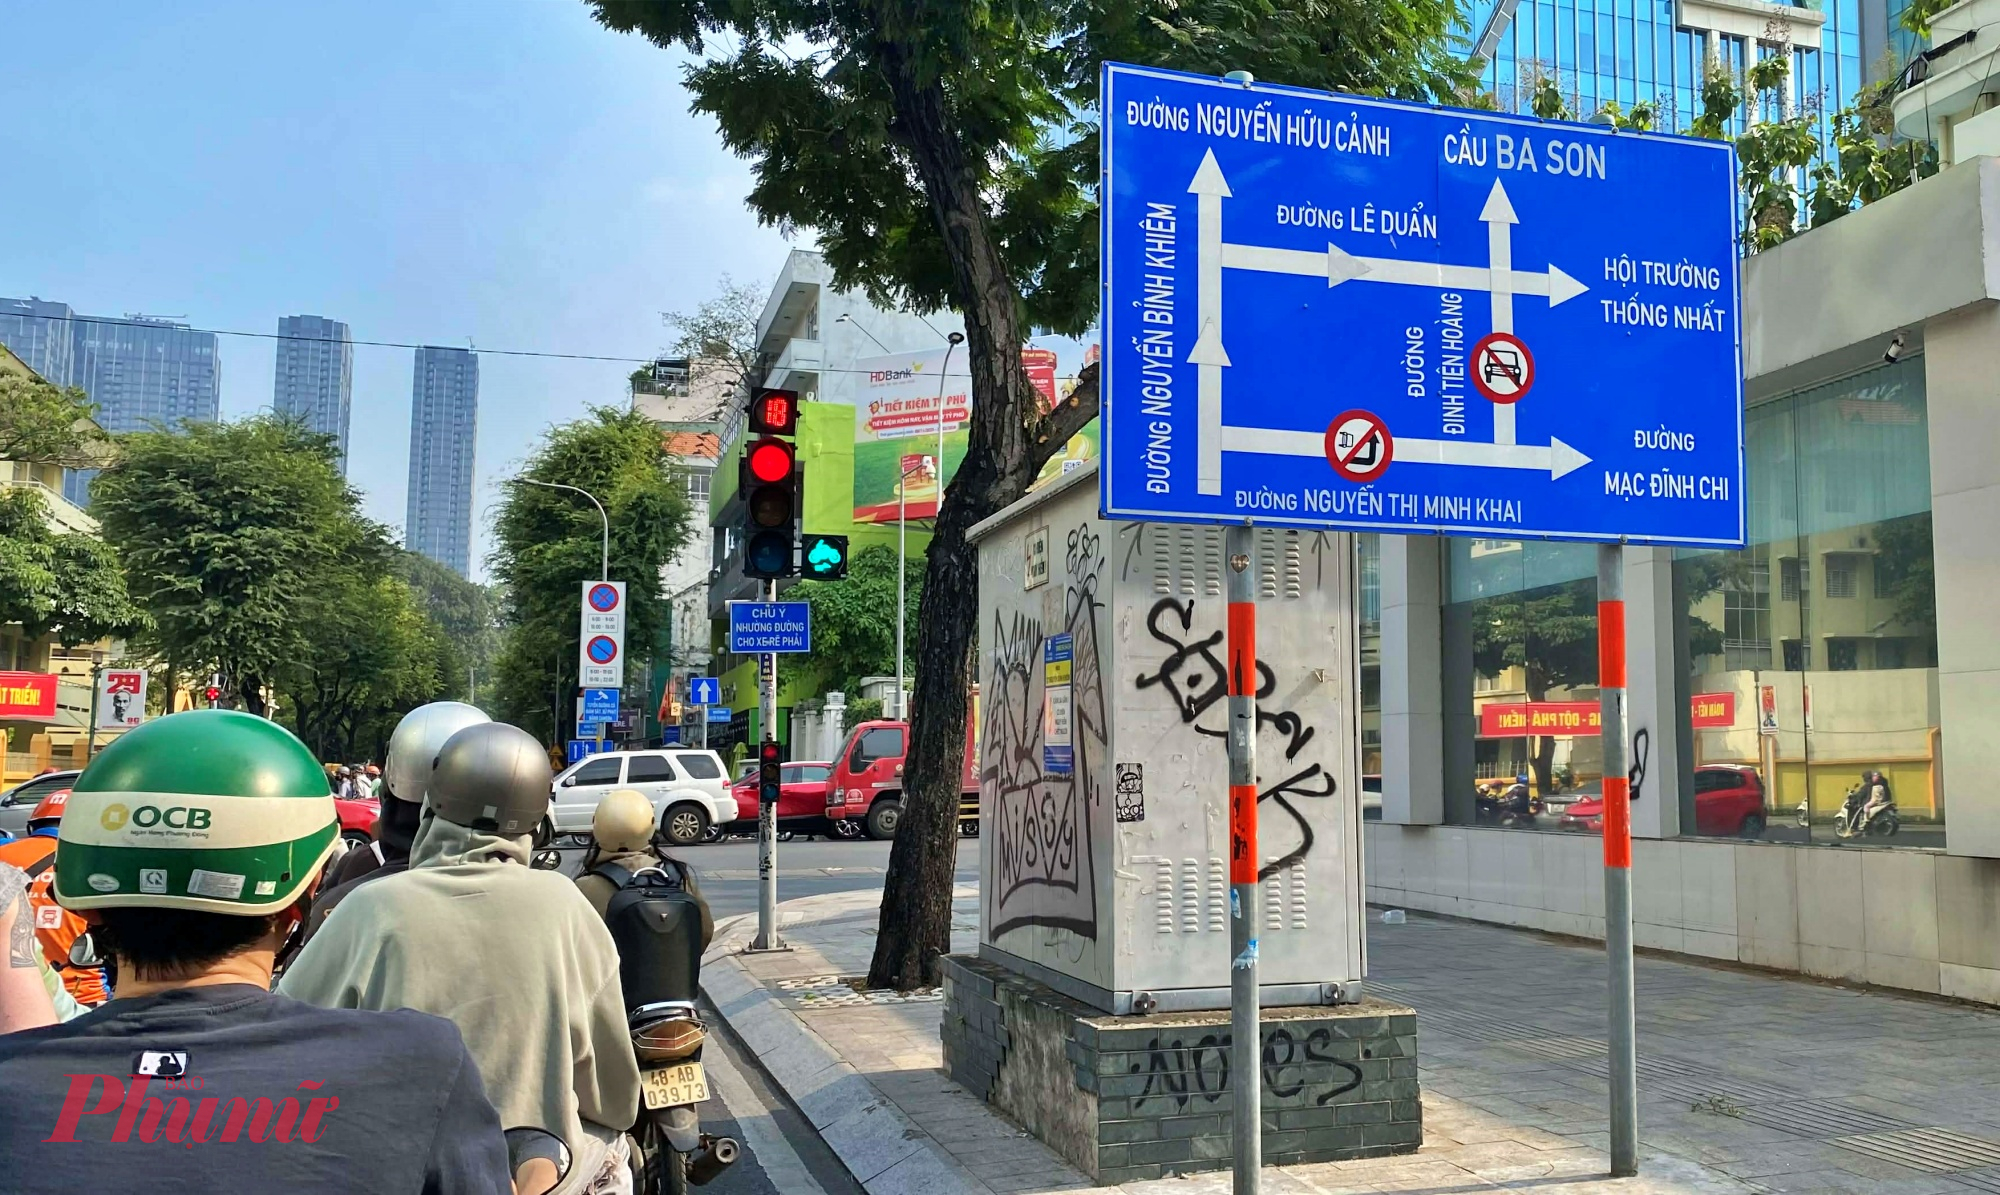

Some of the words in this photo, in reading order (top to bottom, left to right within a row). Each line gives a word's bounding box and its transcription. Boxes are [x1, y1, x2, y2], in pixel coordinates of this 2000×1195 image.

[1127, 95, 1189, 132] ĐƯỜNG
[1197, 100, 1281, 145] NGUYỄN
[1287, 109, 1331, 150] HỮU
[1335, 111, 1391, 158] CẢNH
[1444, 122, 1487, 167] CẦU
[1496, 134, 1538, 173] BA
[1545, 142, 1606, 180] SON
[1138, 202, 1176, 270] KHIÊM
[1277, 200, 1344, 230] ĐƯỜNG
[1351, 202, 1376, 234] LÊ
[1380, 202, 1437, 240] DUẨN
[1604, 252, 1637, 288] HỘI
[1642, 257, 1720, 291] TRƯỜNG
[1132, 273, 1175, 324] BỈNH
[1600, 292, 1668, 328] THỐNG
[1674, 299, 1726, 333] NHẤT
[1434, 292, 1464, 351] HOÀNG
[870, 368, 912, 383] HDBank
[1132, 329, 1174, 417] NGUYỄN
[1400, 326, 1426, 398] ĐƯỜNG
[1435, 354, 1465, 391] TIÊN
[884, 398, 902, 413] TIẾT
[905, 397, 929, 412] KIỆM
[946, 392, 966, 406] PHÚ
[1441, 394, 1466, 435] ĐINH
[1140, 420, 1172, 494] ĐƯỜNG
[1633, 428, 1695, 452] ĐƯỜNG
[1234, 487, 1298, 512] ĐƯỜNG
[1304, 484, 1383, 517] NGUYỄN
[1388, 491, 1418, 524] THỊ
[1424, 496, 1470, 521] MINH
[1475, 498, 1522, 524] KHAI
[1604, 471, 1645, 502] MẠC
[1649, 467, 1695, 499] ĐĨNH
[1699, 476, 1729, 501] CHI
[735, 621, 773, 633] NHƯỜNG
[774, 620, 805, 632] ĐƯỜNG
[751, 605, 776, 619] CHÚ
[778, 605, 787, 619] Ý
[737, 636, 755, 647] CHO
[782, 633, 803, 647] PHẢI
[107, 673, 141, 695] 29
[133, 805, 212, 829] OCB
[647, 1083, 705, 1106] 039.73
